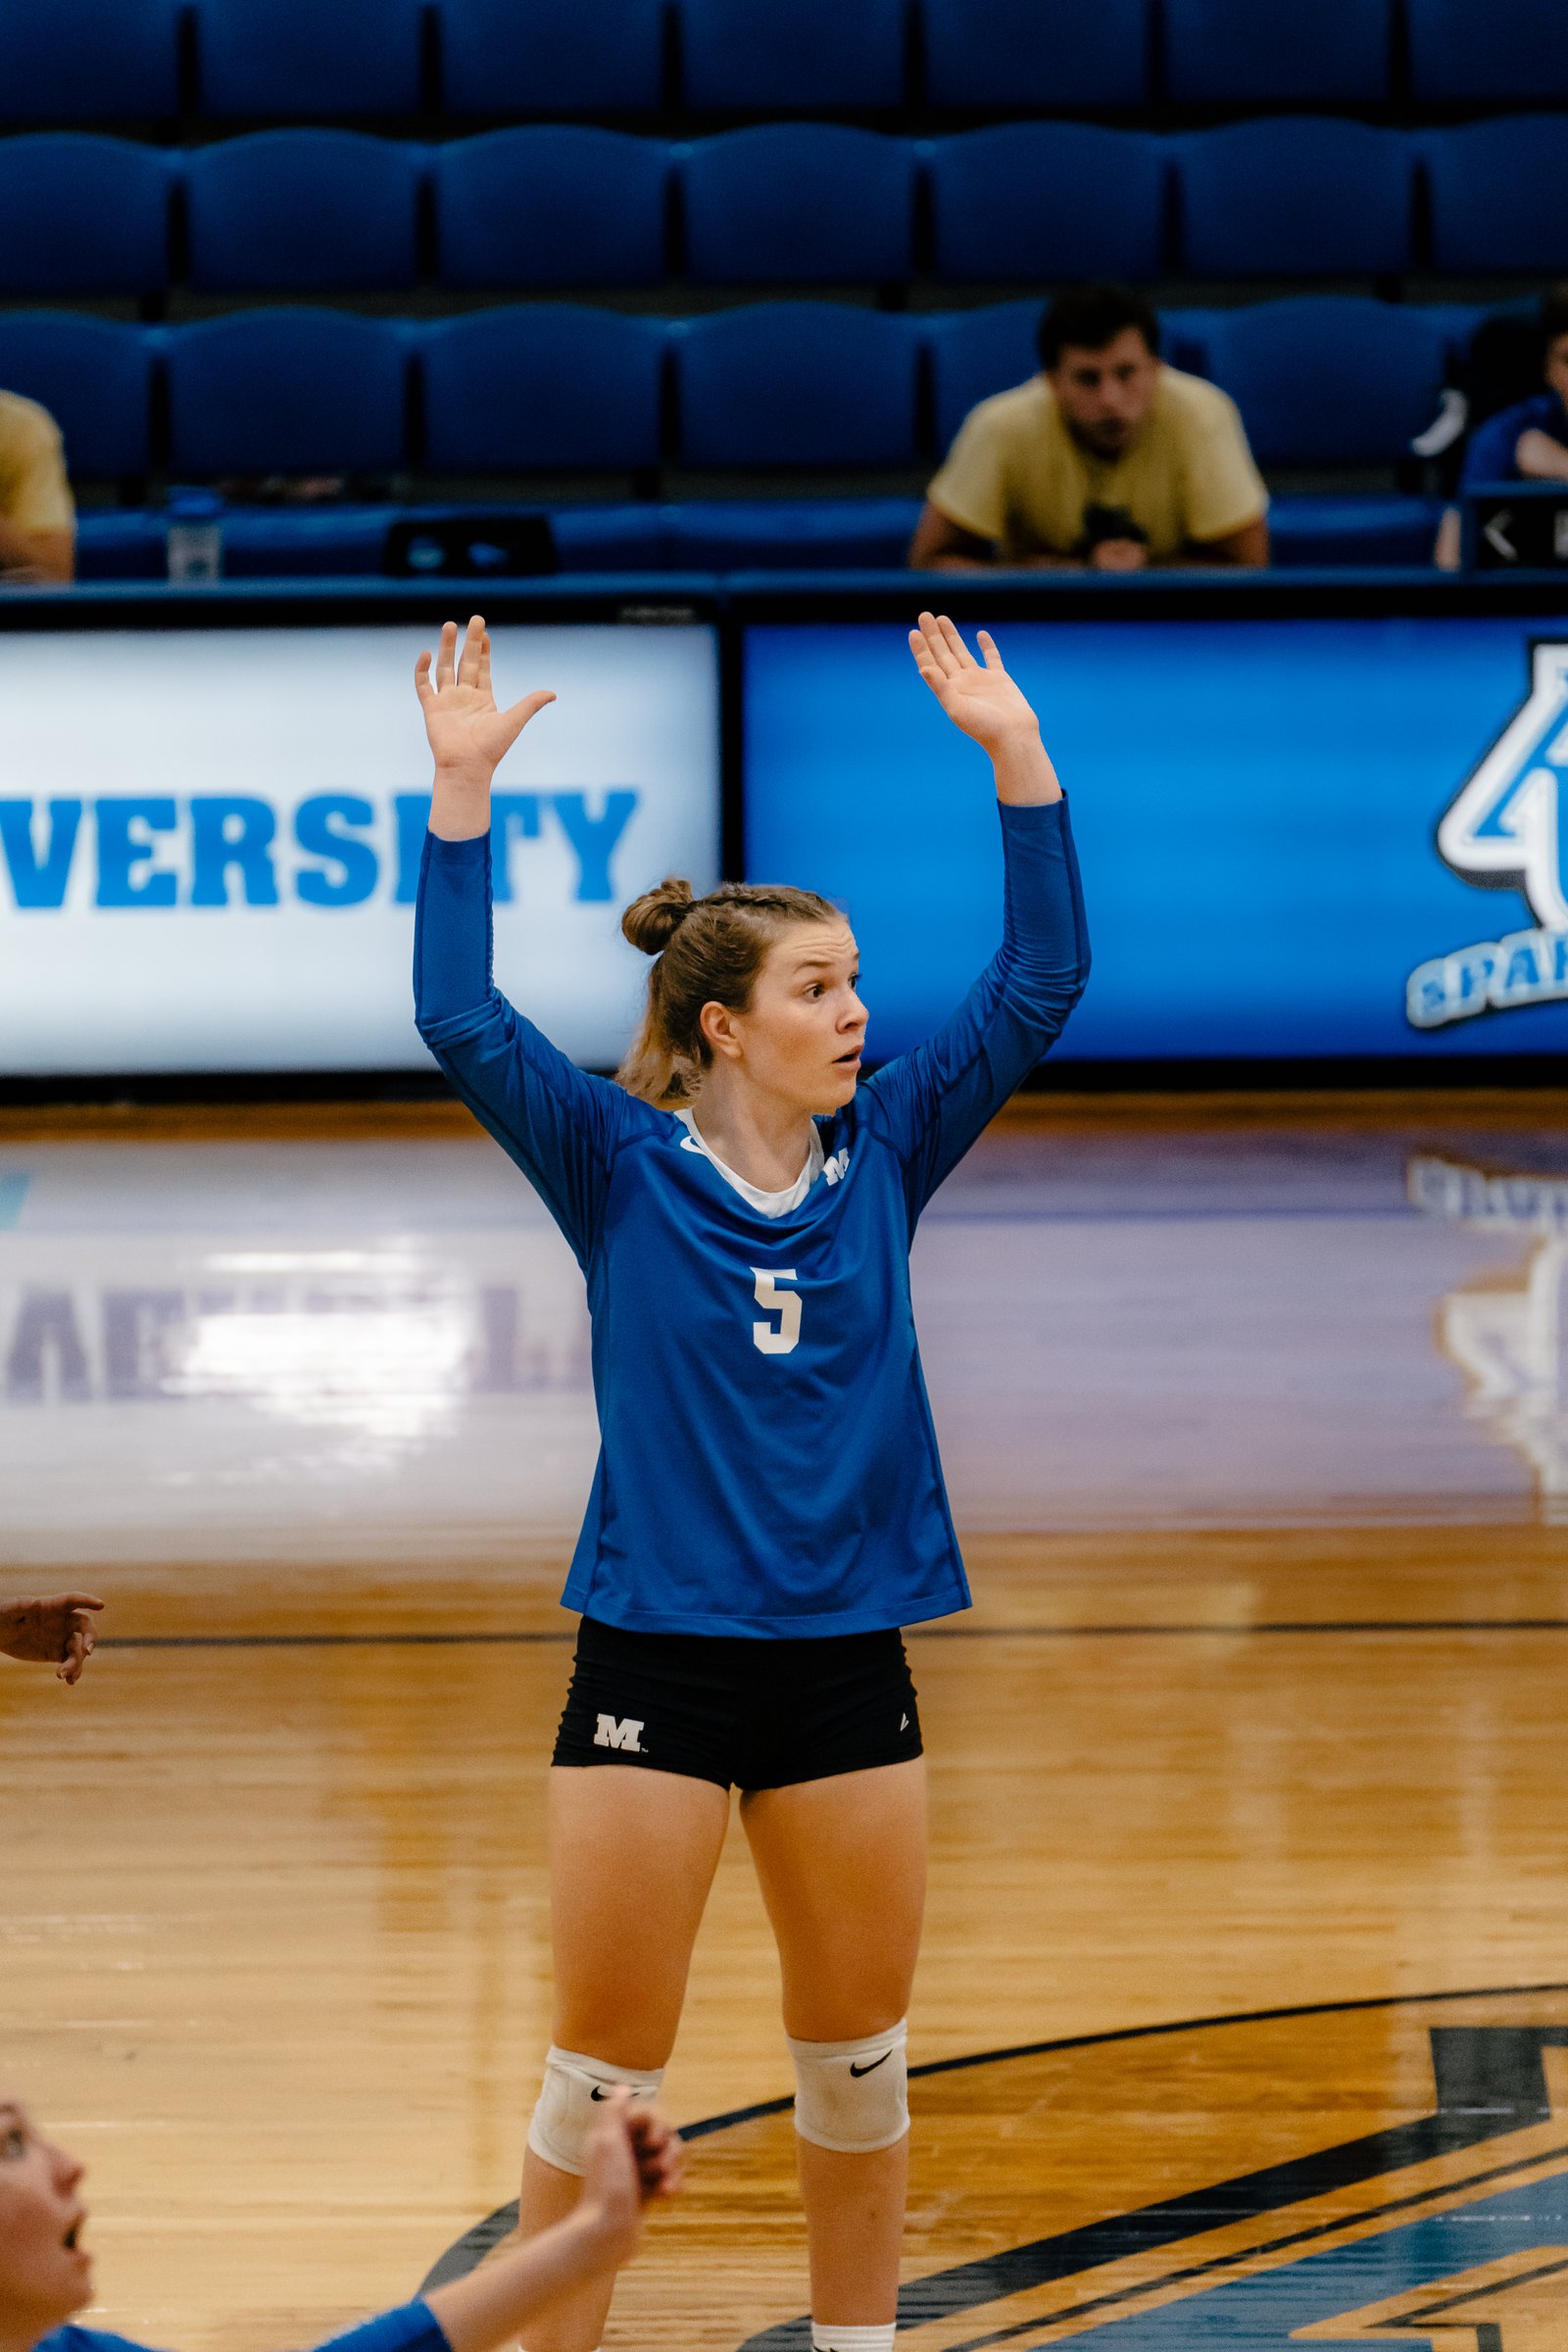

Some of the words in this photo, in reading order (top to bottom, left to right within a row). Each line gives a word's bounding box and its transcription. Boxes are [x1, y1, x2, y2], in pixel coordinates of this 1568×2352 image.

[822, 1148, 850, 1186] M
[750, 1267, 803, 1354] 5
[593, 1713, 645, 1752] M
